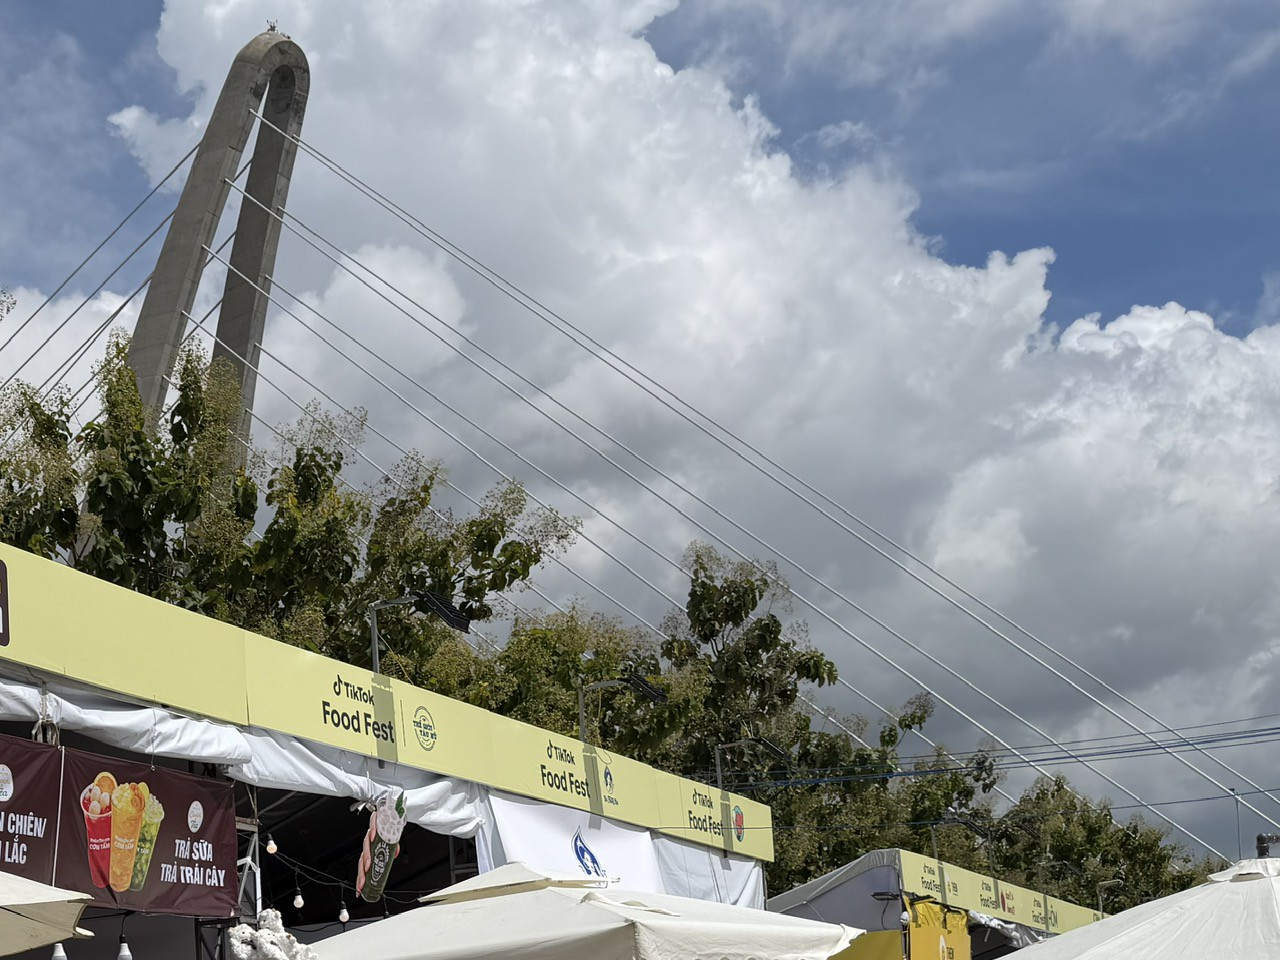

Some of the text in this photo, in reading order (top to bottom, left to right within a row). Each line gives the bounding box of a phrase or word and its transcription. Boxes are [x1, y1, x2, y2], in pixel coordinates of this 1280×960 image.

[343, 681, 376, 706] TikTok
[321, 700, 361, 734] Food
[364, 712, 395, 743] Fest
[553, 745, 576, 765] TikTok
[540, 764, 591, 799] Food Fest
[688, 809, 708, 833] Food
[708, 815, 724, 838] Fest
[4, 834, 28, 865] LẮC
[192, 839, 213, 862] SỮA
[205, 865, 226, 887] CÂY
